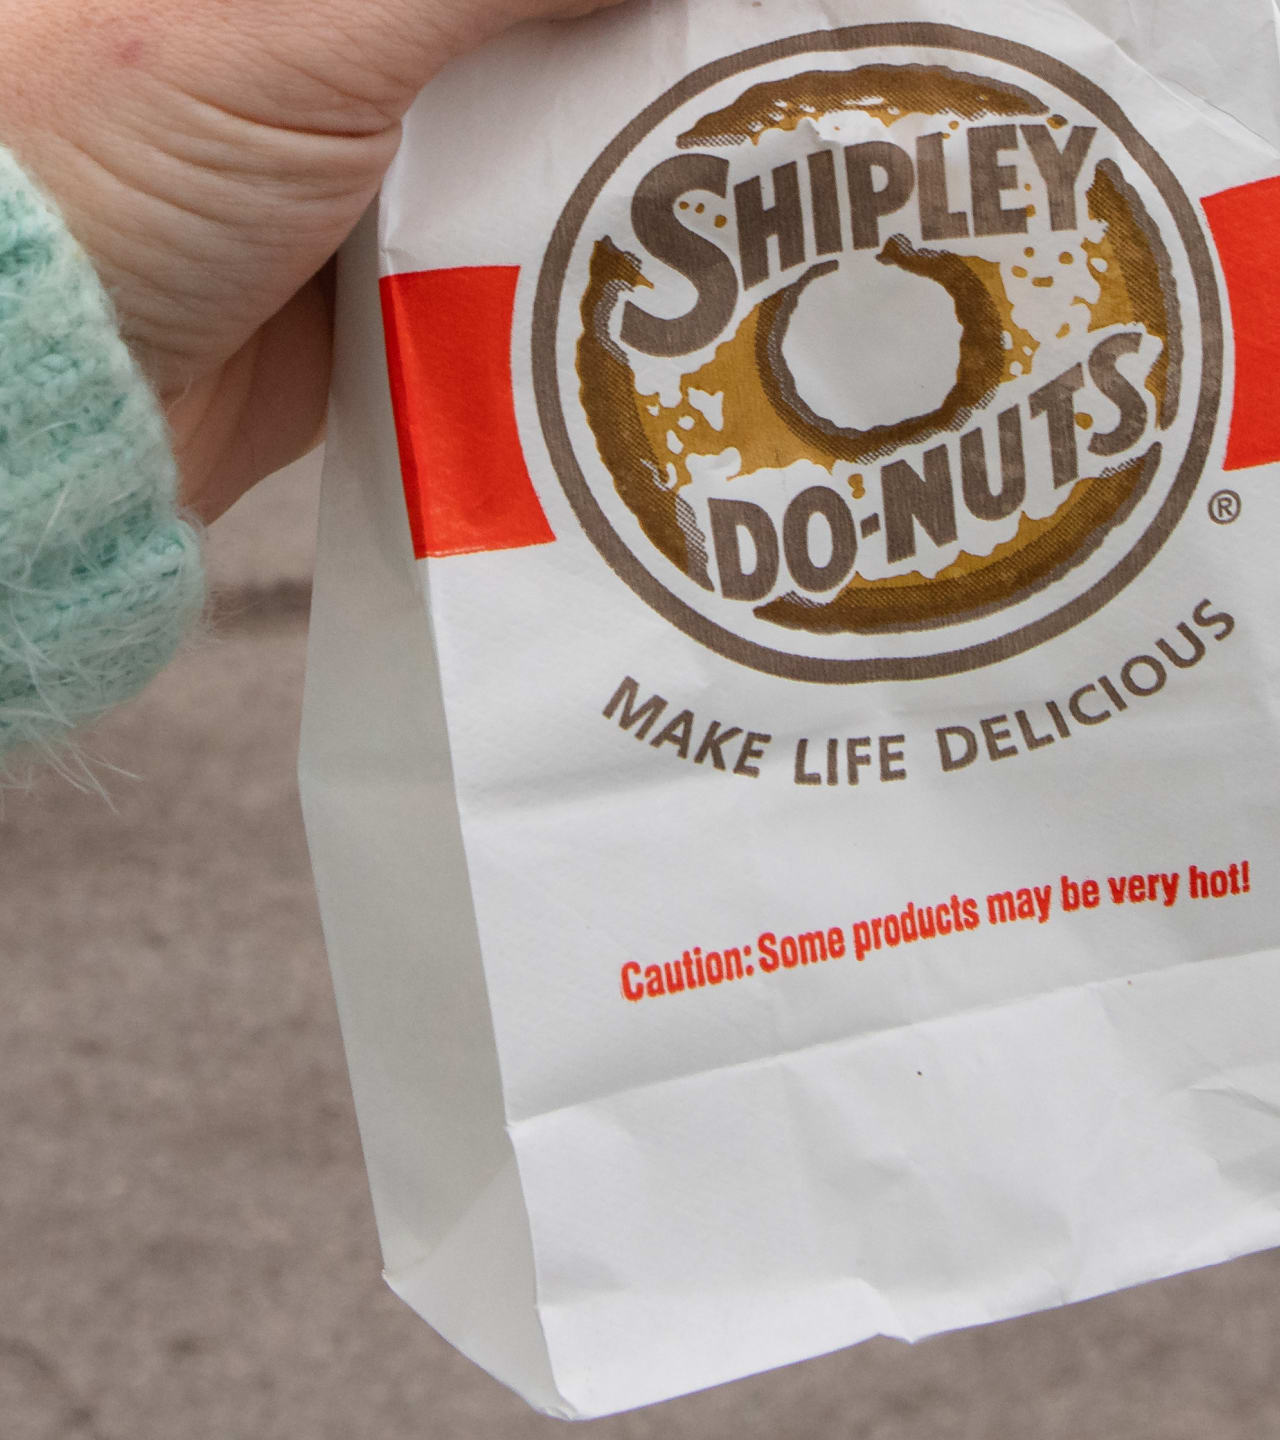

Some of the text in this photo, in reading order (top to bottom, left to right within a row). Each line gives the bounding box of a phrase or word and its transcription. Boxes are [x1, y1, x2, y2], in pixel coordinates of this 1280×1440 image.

[619, 124, 1098, 358] SHIPLEY
[708, 332, 1148, 602] DO-NUTS
[602, 598, 1236, 786] MAKE LIFE DELICIOUS
[621, 860, 1251, 1002] Caution: Some products may be very hot!
